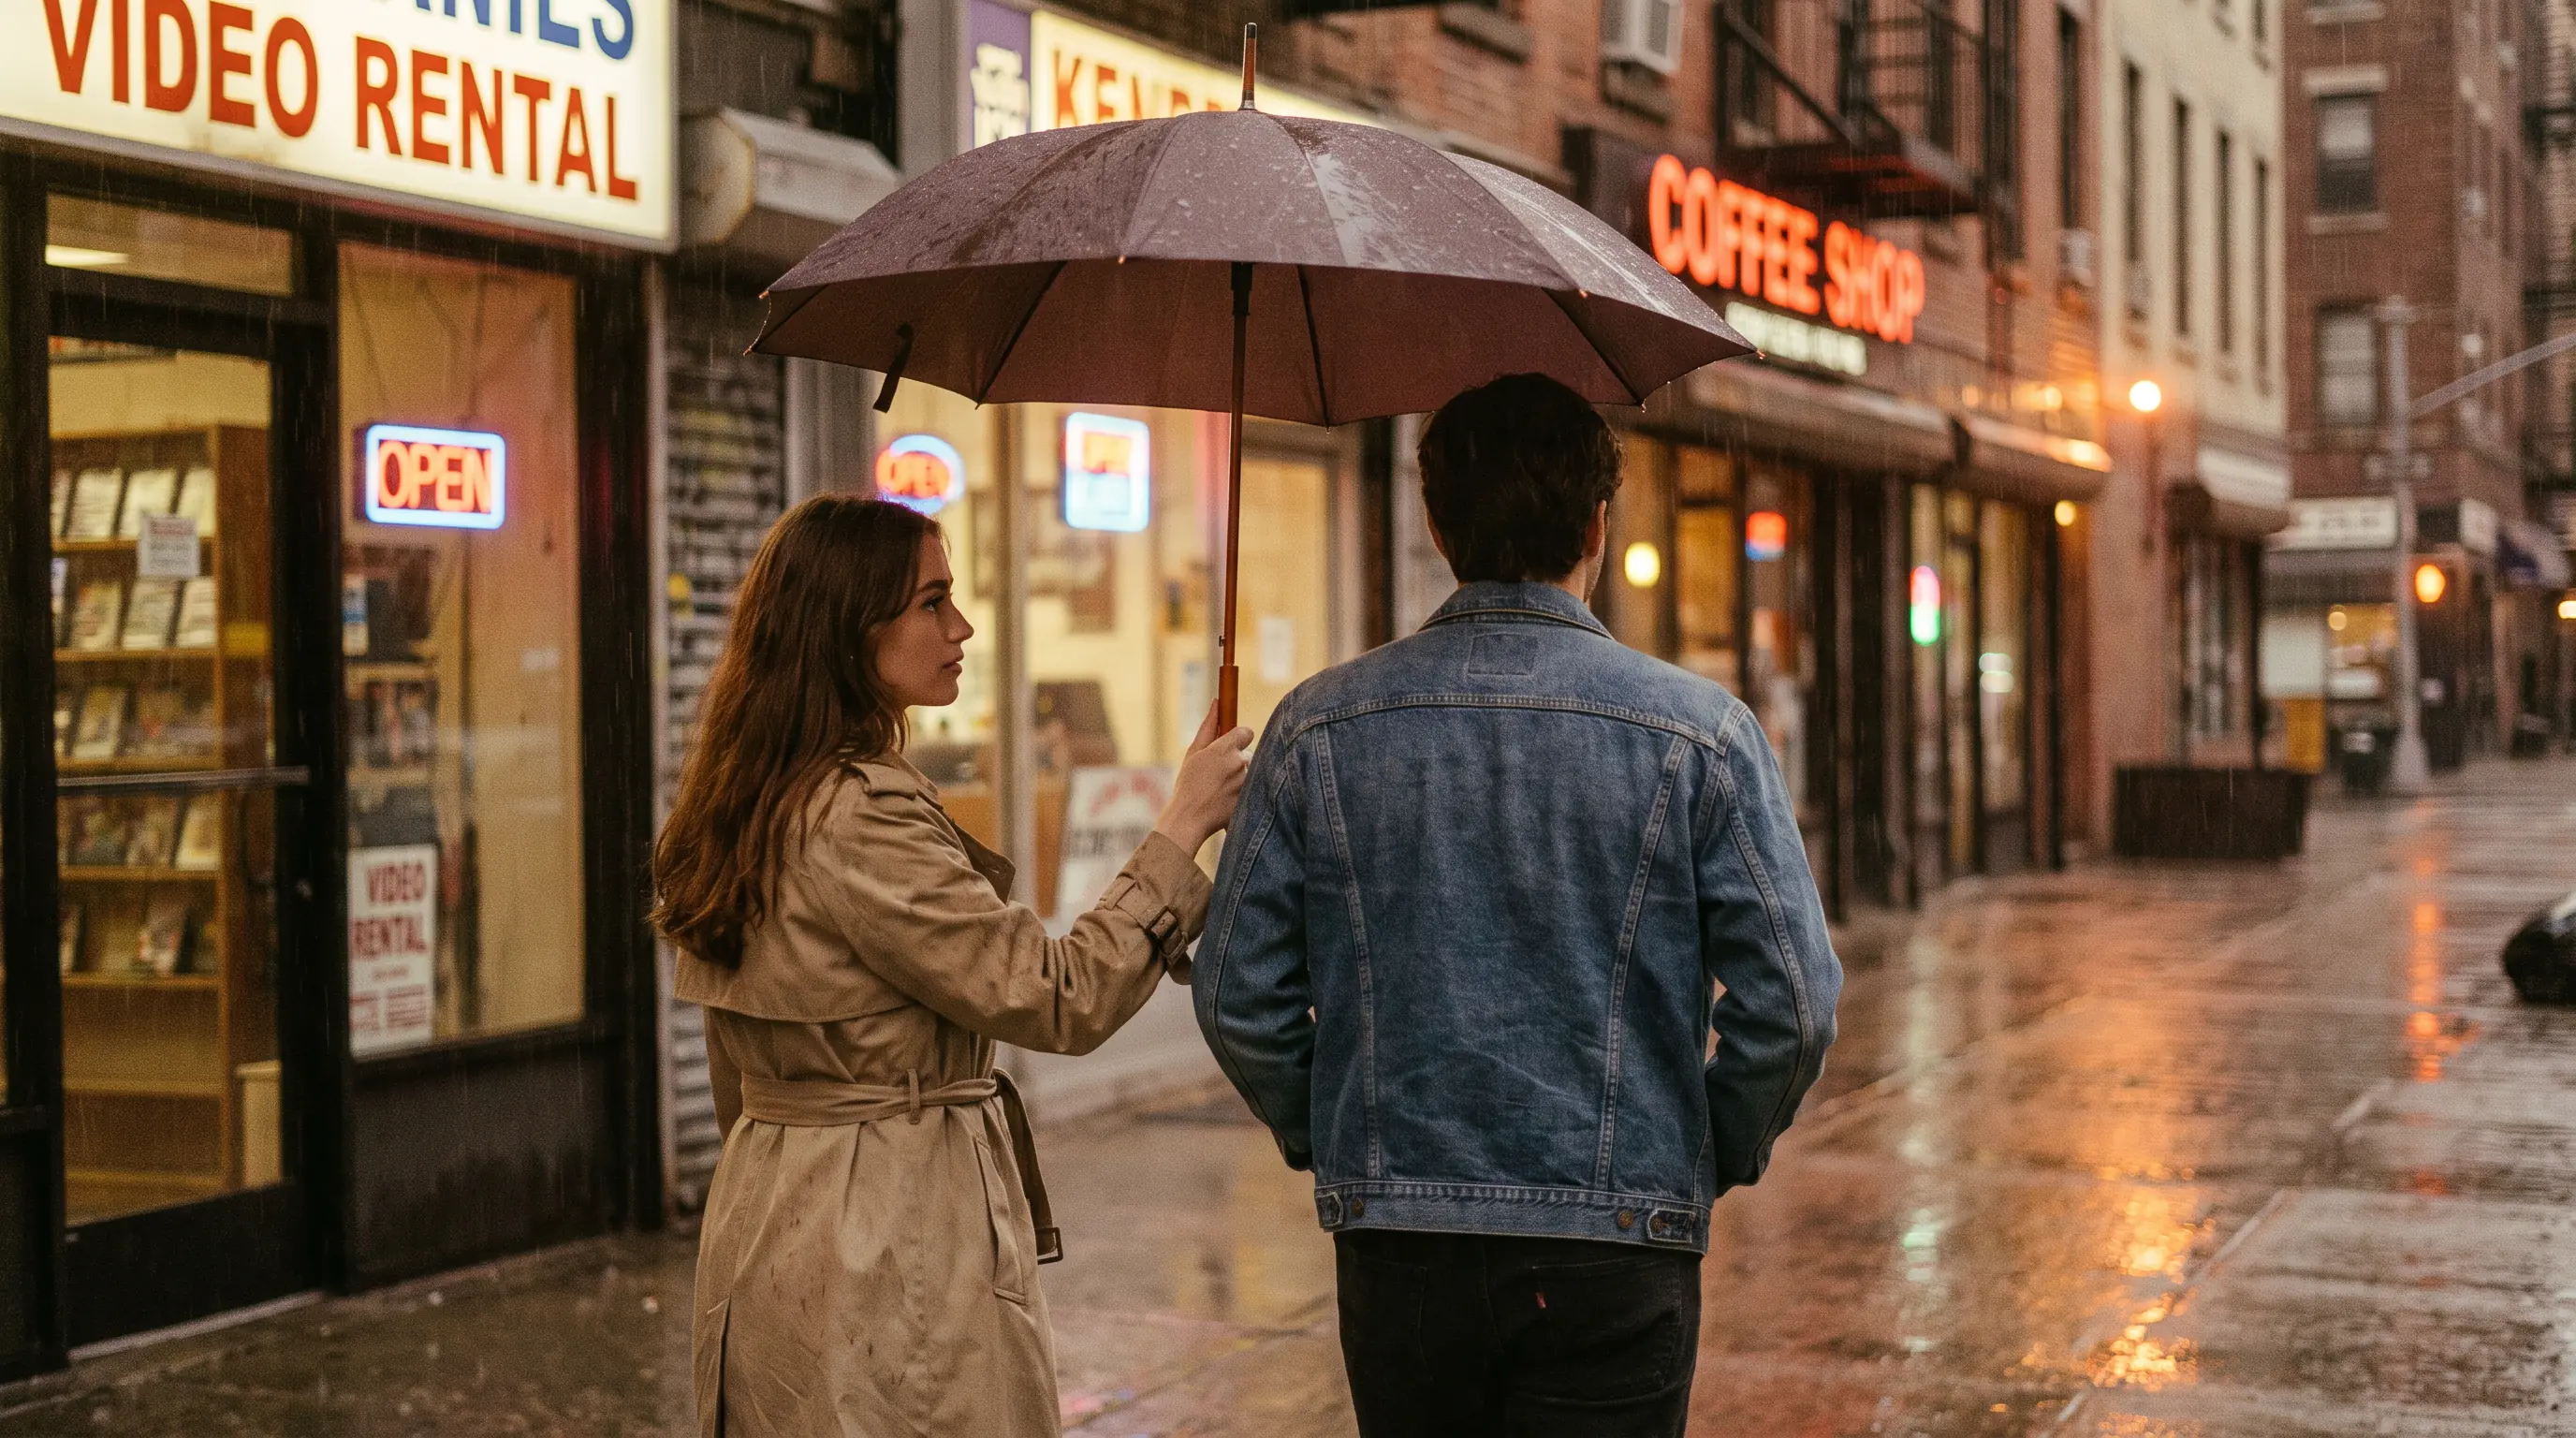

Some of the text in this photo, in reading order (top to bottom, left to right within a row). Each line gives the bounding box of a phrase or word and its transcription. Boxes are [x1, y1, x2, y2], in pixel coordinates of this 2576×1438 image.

[43, 0, 638, 202] VIDEO RENTAL
[1649, 154, 1821, 315] COFFEE
[1823, 221, 1925, 345] SHOP
[377, 440, 493, 513] OPEN
[367, 860, 427, 903] VIDEO
[350, 915, 429, 958] RENTAL
